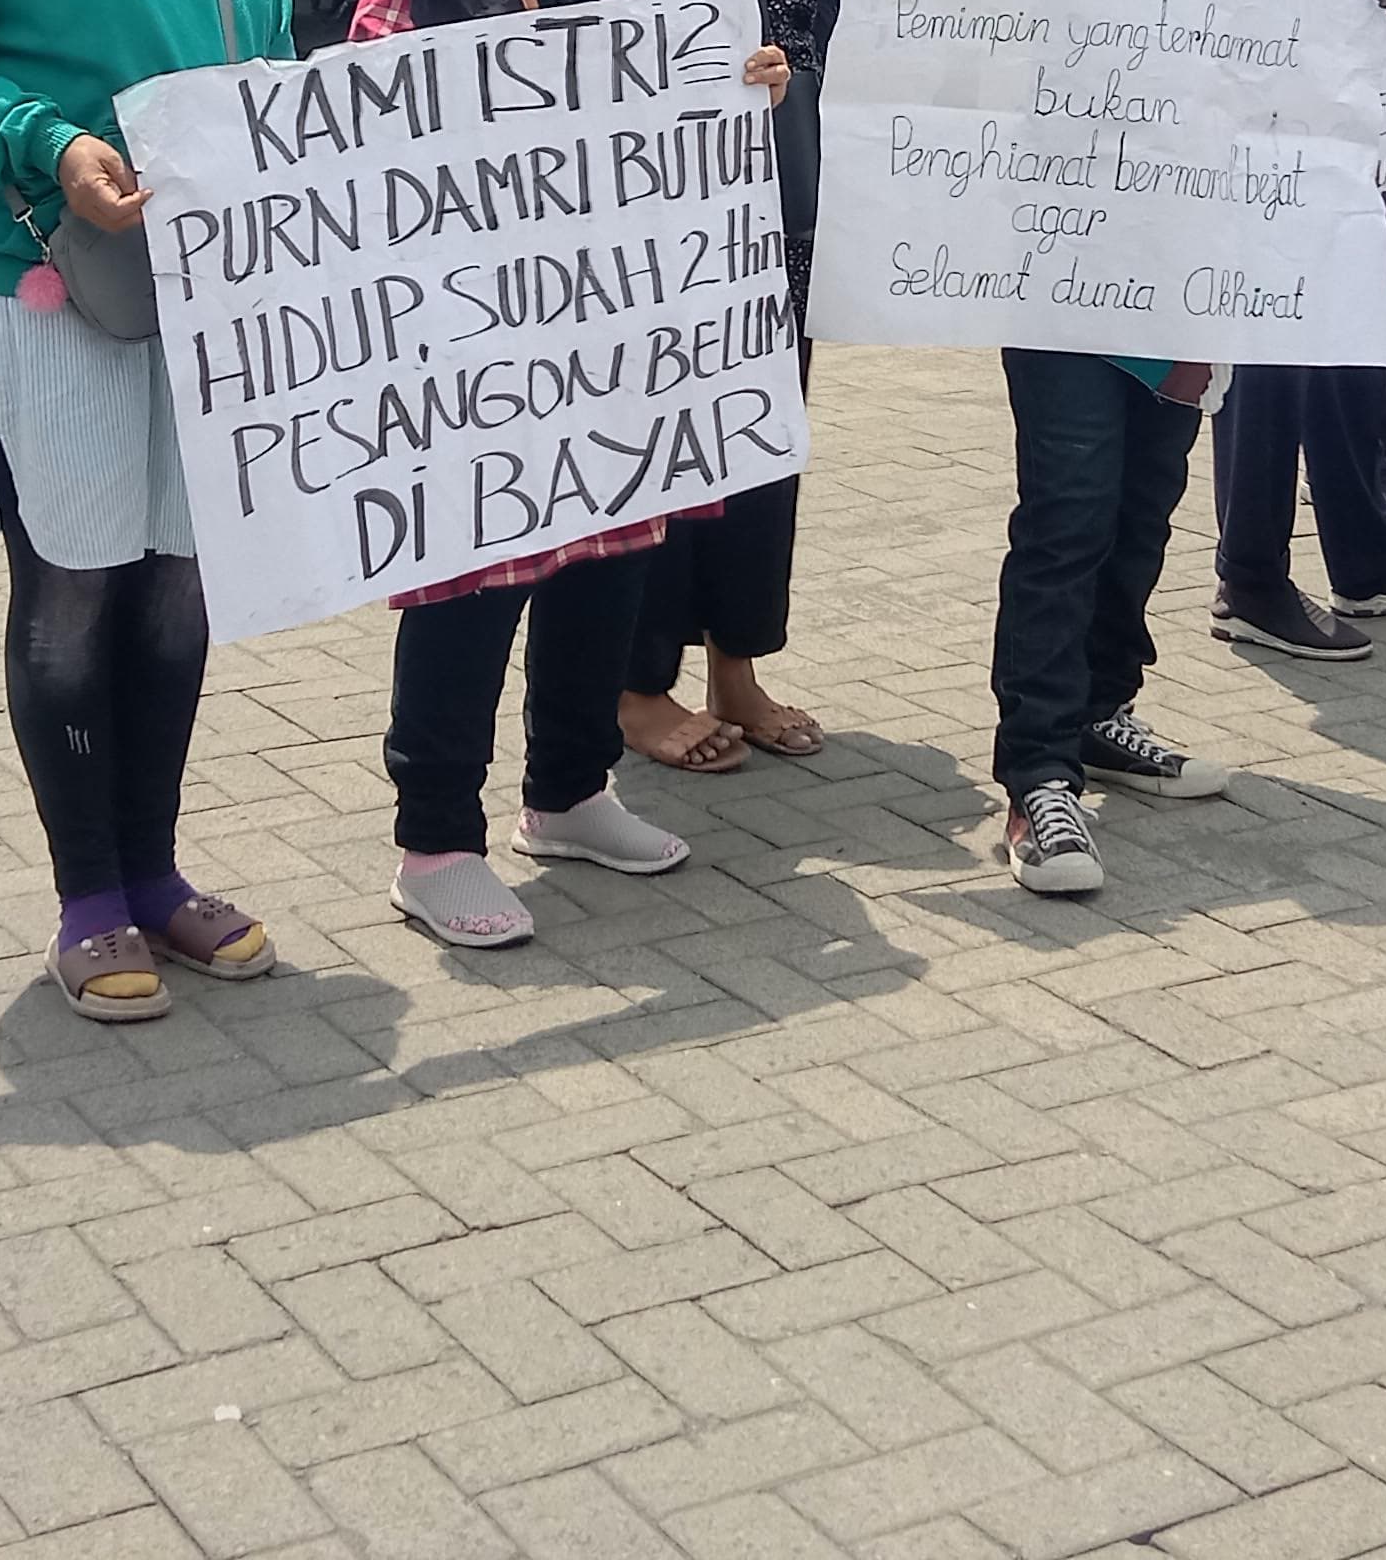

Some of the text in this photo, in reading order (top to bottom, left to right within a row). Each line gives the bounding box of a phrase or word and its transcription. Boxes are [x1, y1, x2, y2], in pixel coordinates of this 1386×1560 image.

[1034, 65, 1181, 126] bukan
[1066, 19, 1150, 71] yang
[167, 108, 774, 300] PURN DAMRI BUTUH
[891, 115, 1099, 198] Penghianat
[1245, 146, 1307, 221] bejat
[1013, 201, 1107, 254] agar
[442, 238, 663, 343] SUDAH
[1051, 255, 1155, 314] dunia
[231, 289, 796, 518] PESANGON BELUM
[469, 388, 797, 551] BAYAR
